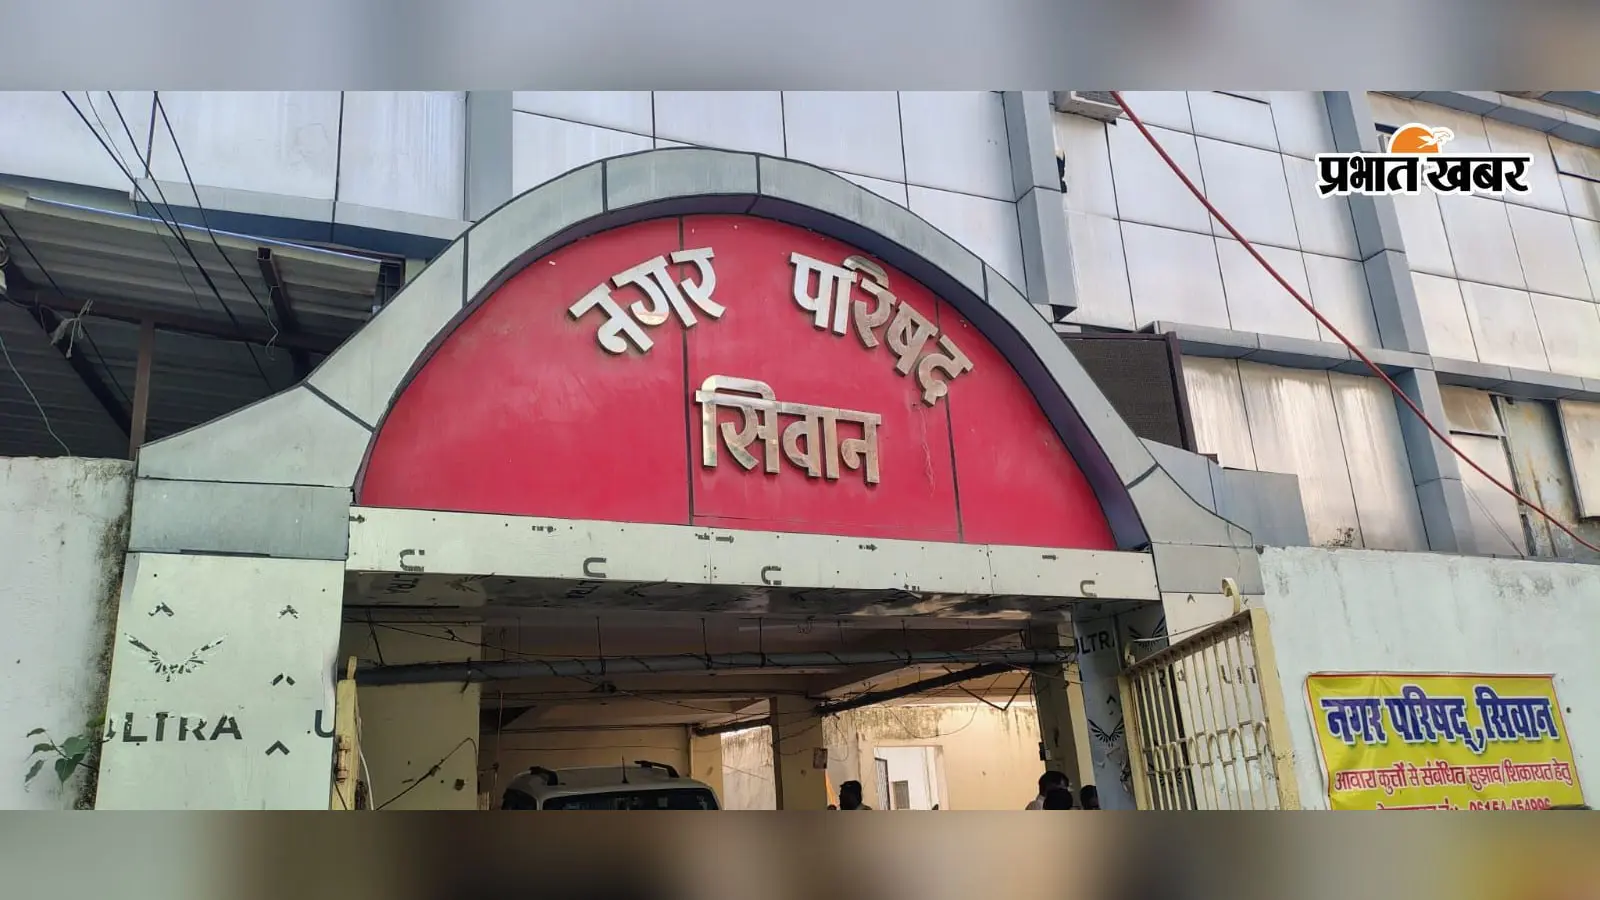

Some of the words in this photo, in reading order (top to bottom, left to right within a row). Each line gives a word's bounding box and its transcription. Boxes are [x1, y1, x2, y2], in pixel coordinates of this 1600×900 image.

[568, 246, 726, 355] नगर
[789, 251, 974, 407] परिषद
[695, 374, 882, 485] सिवान
[1320, 698, 1386, 742] नगर
[1474, 685, 1559, 740] सिवान
[1334, 770, 1377, 791] आवारा
[1408, 763, 1420, 787] से
